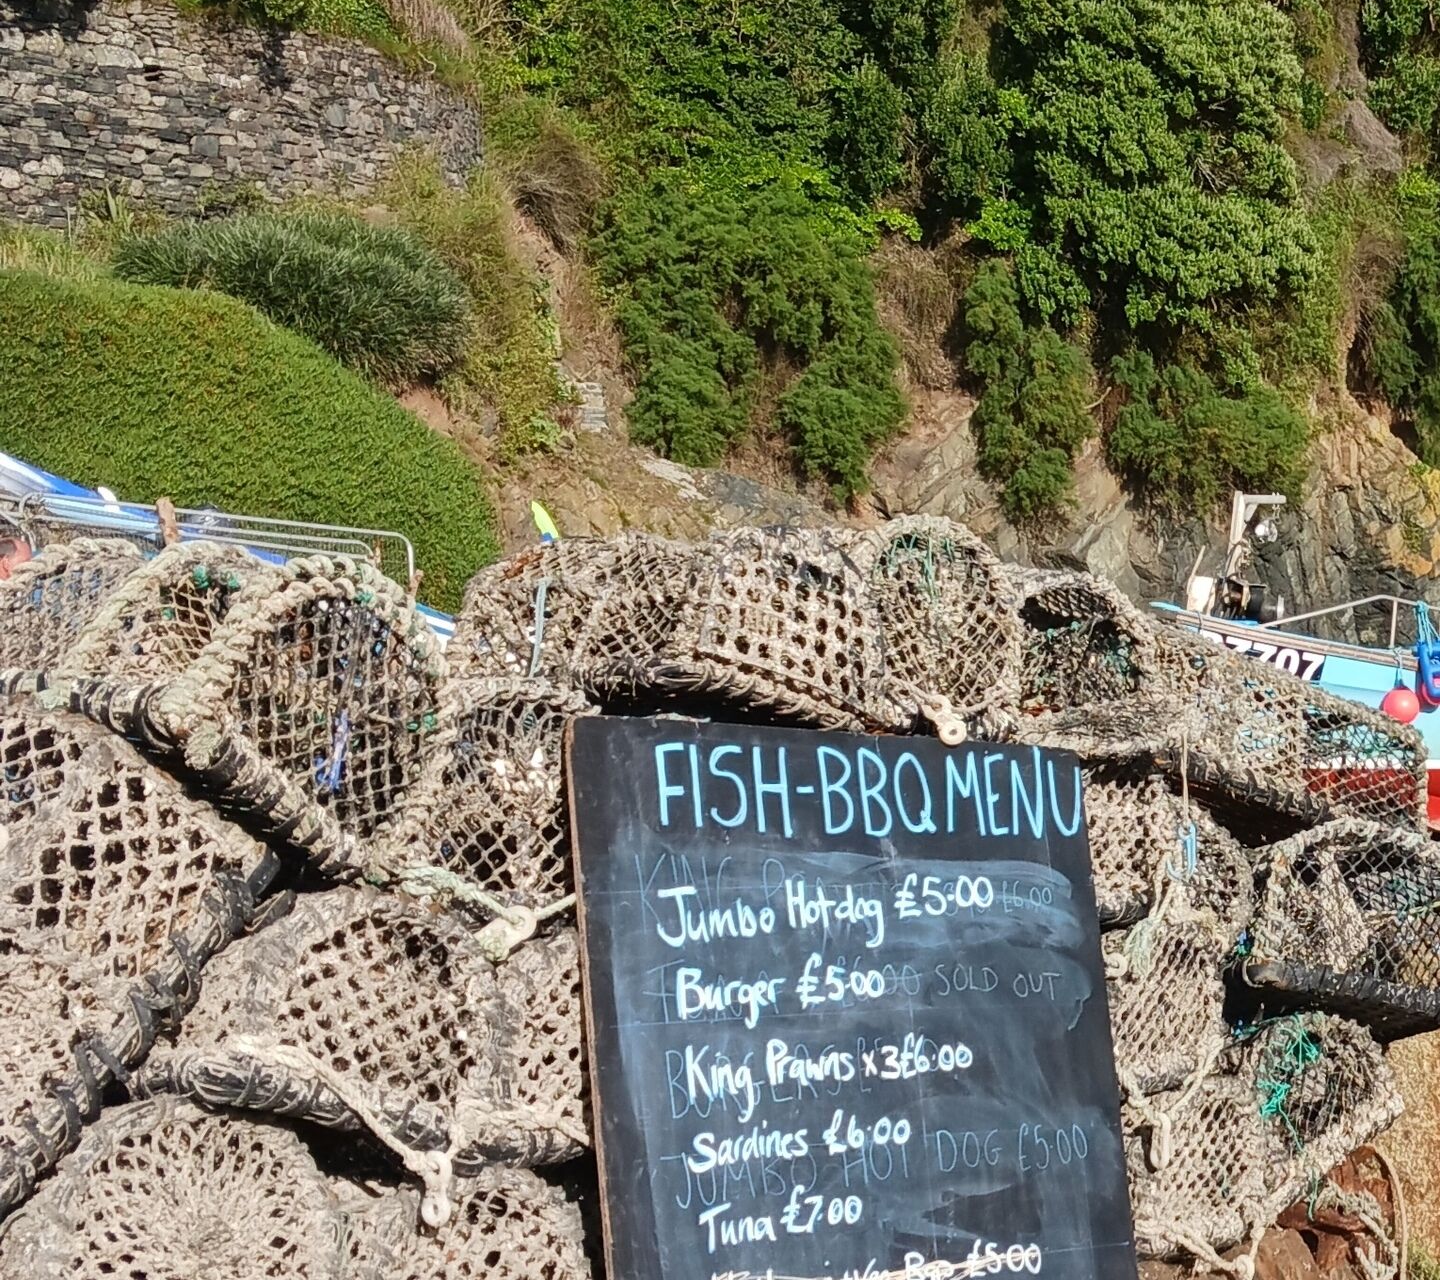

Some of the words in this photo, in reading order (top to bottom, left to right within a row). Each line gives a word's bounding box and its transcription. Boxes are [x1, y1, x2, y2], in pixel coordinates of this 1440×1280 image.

[944, 746, 1082, 838] MENU
[657, 884, 776, 948] Jumbo
[676, 967, 787, 1030] Burger
[934, 964, 998, 997] SOLD
[1013, 972, 1062, 1000] OUT
[685, 1043, 755, 1123] King
[765, 1038, 854, 1086] Prawns
[688, 1120, 809, 1174] Sardines
[936, 1128, 1002, 1172] DOG
[698, 1202, 777, 1254] Tuna
